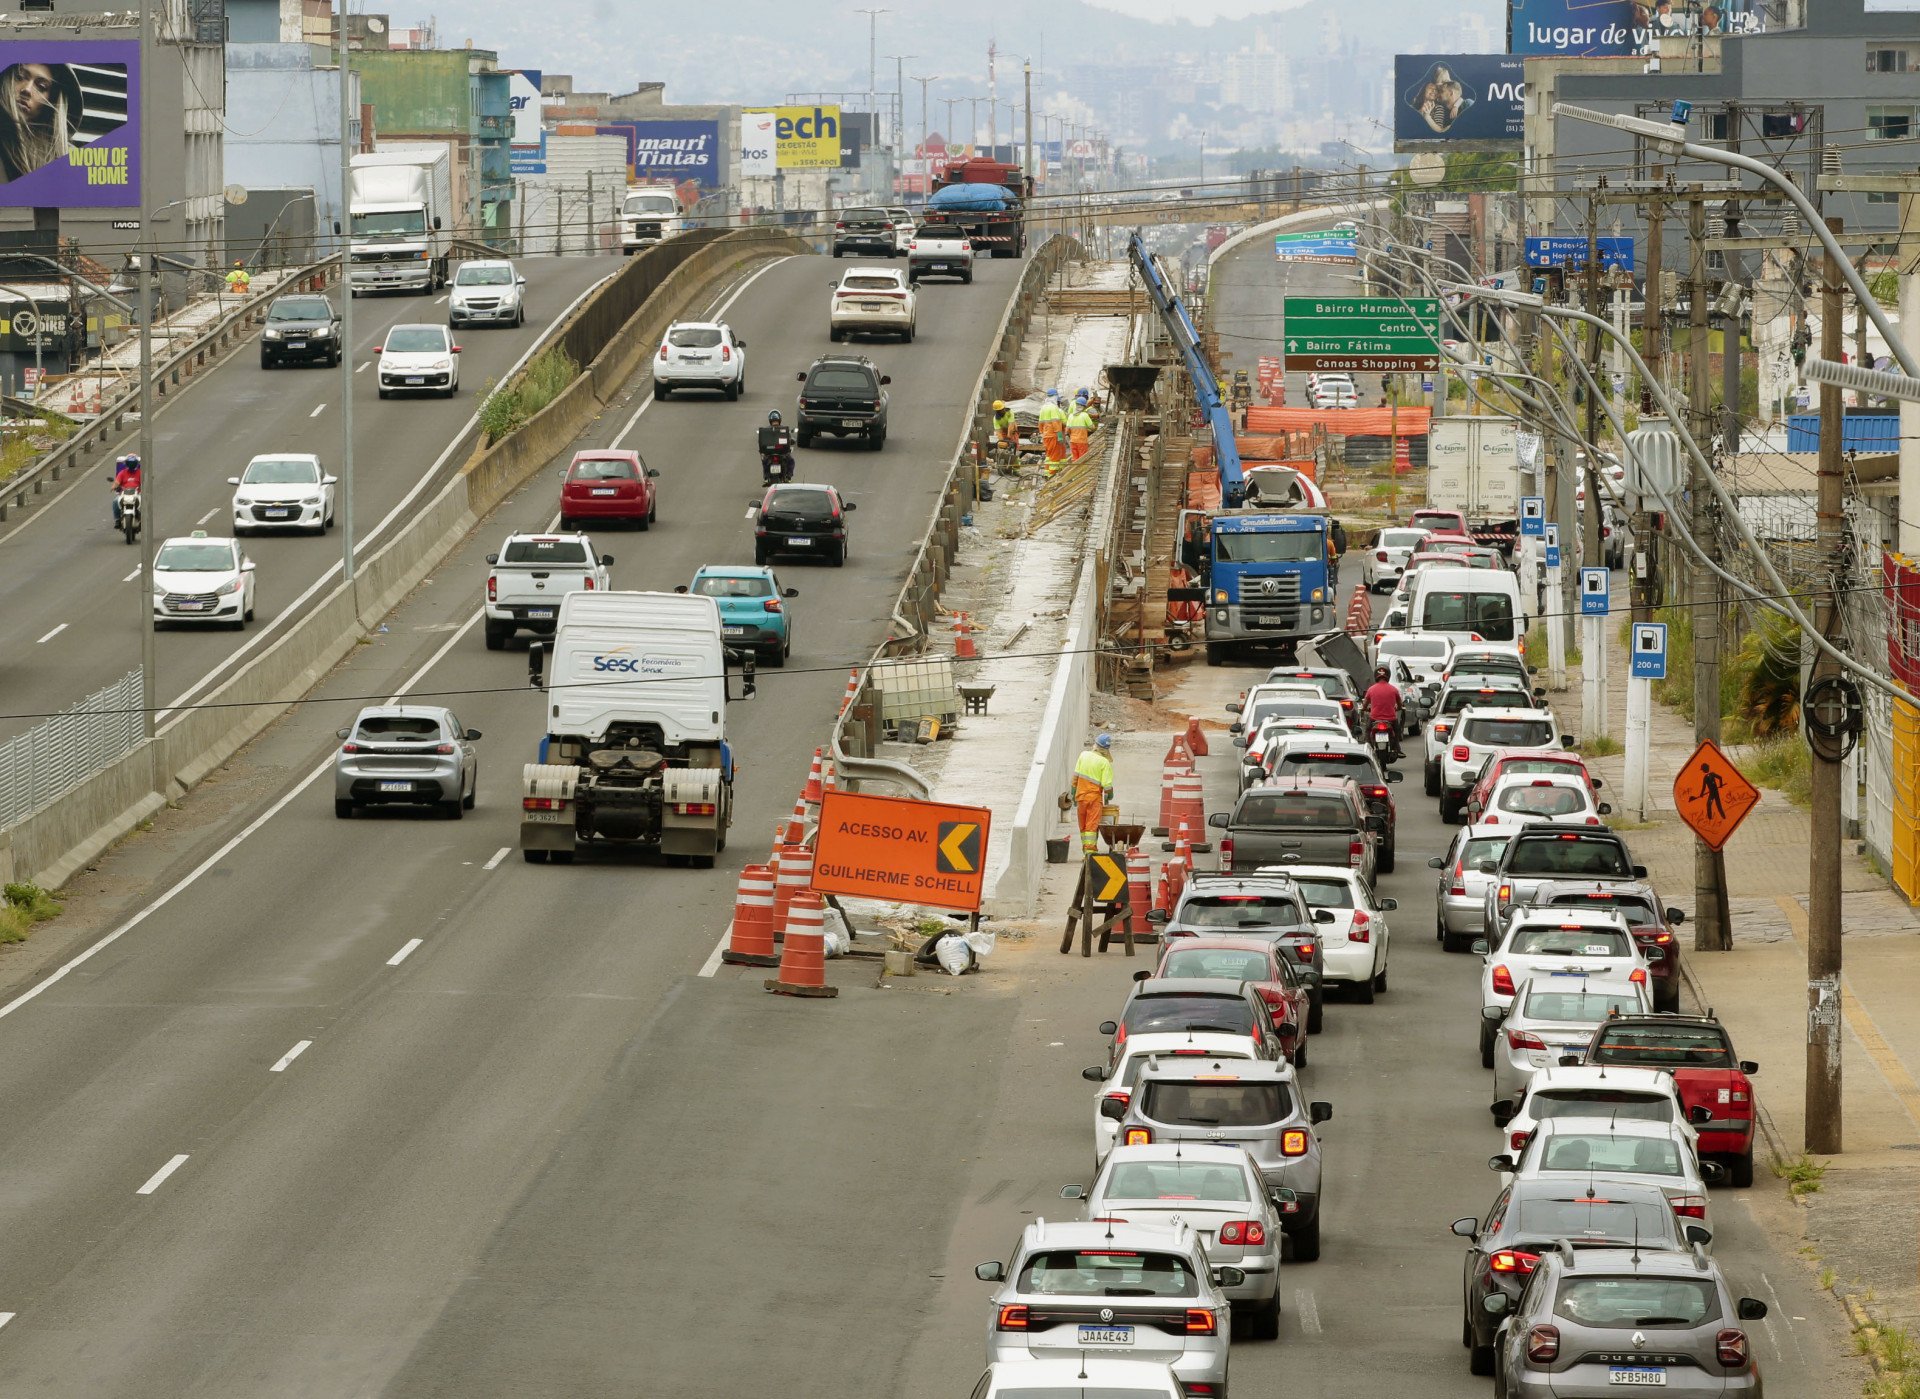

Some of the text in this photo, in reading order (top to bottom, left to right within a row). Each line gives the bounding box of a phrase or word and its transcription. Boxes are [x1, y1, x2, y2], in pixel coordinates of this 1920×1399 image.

[1528, 22, 1596, 48] lugar
[1600, 22, 1627, 44] de
[637, 134, 707, 150] mauri
[68, 147, 128, 167] WOW OF
[637, 151, 709, 165] Tintas
[87, 166, 129, 185] HOME
[1315, 304, 1417, 313] Bairro Harmonia
[1379, 323, 1417, 332] Centro
[1306, 340, 1391, 350] Bairro Fátima
[1315, 359, 1417, 370] Canoas Shopping
[593, 655, 681, 673] Sesc Fecomércio
[1636, 661, 1652, 669] 200
[838, 822, 929, 844] ACESSO AV.
[818, 863, 975, 894] GUILHERME SCHELL
[1206, 1129, 1226, 1138] Jeep
[1082, 1331, 1129, 1342] JAA4E43
[1600, 1354, 1677, 1363] DUSTER
[1614, 1371, 1661, 1383] SFB5H80
